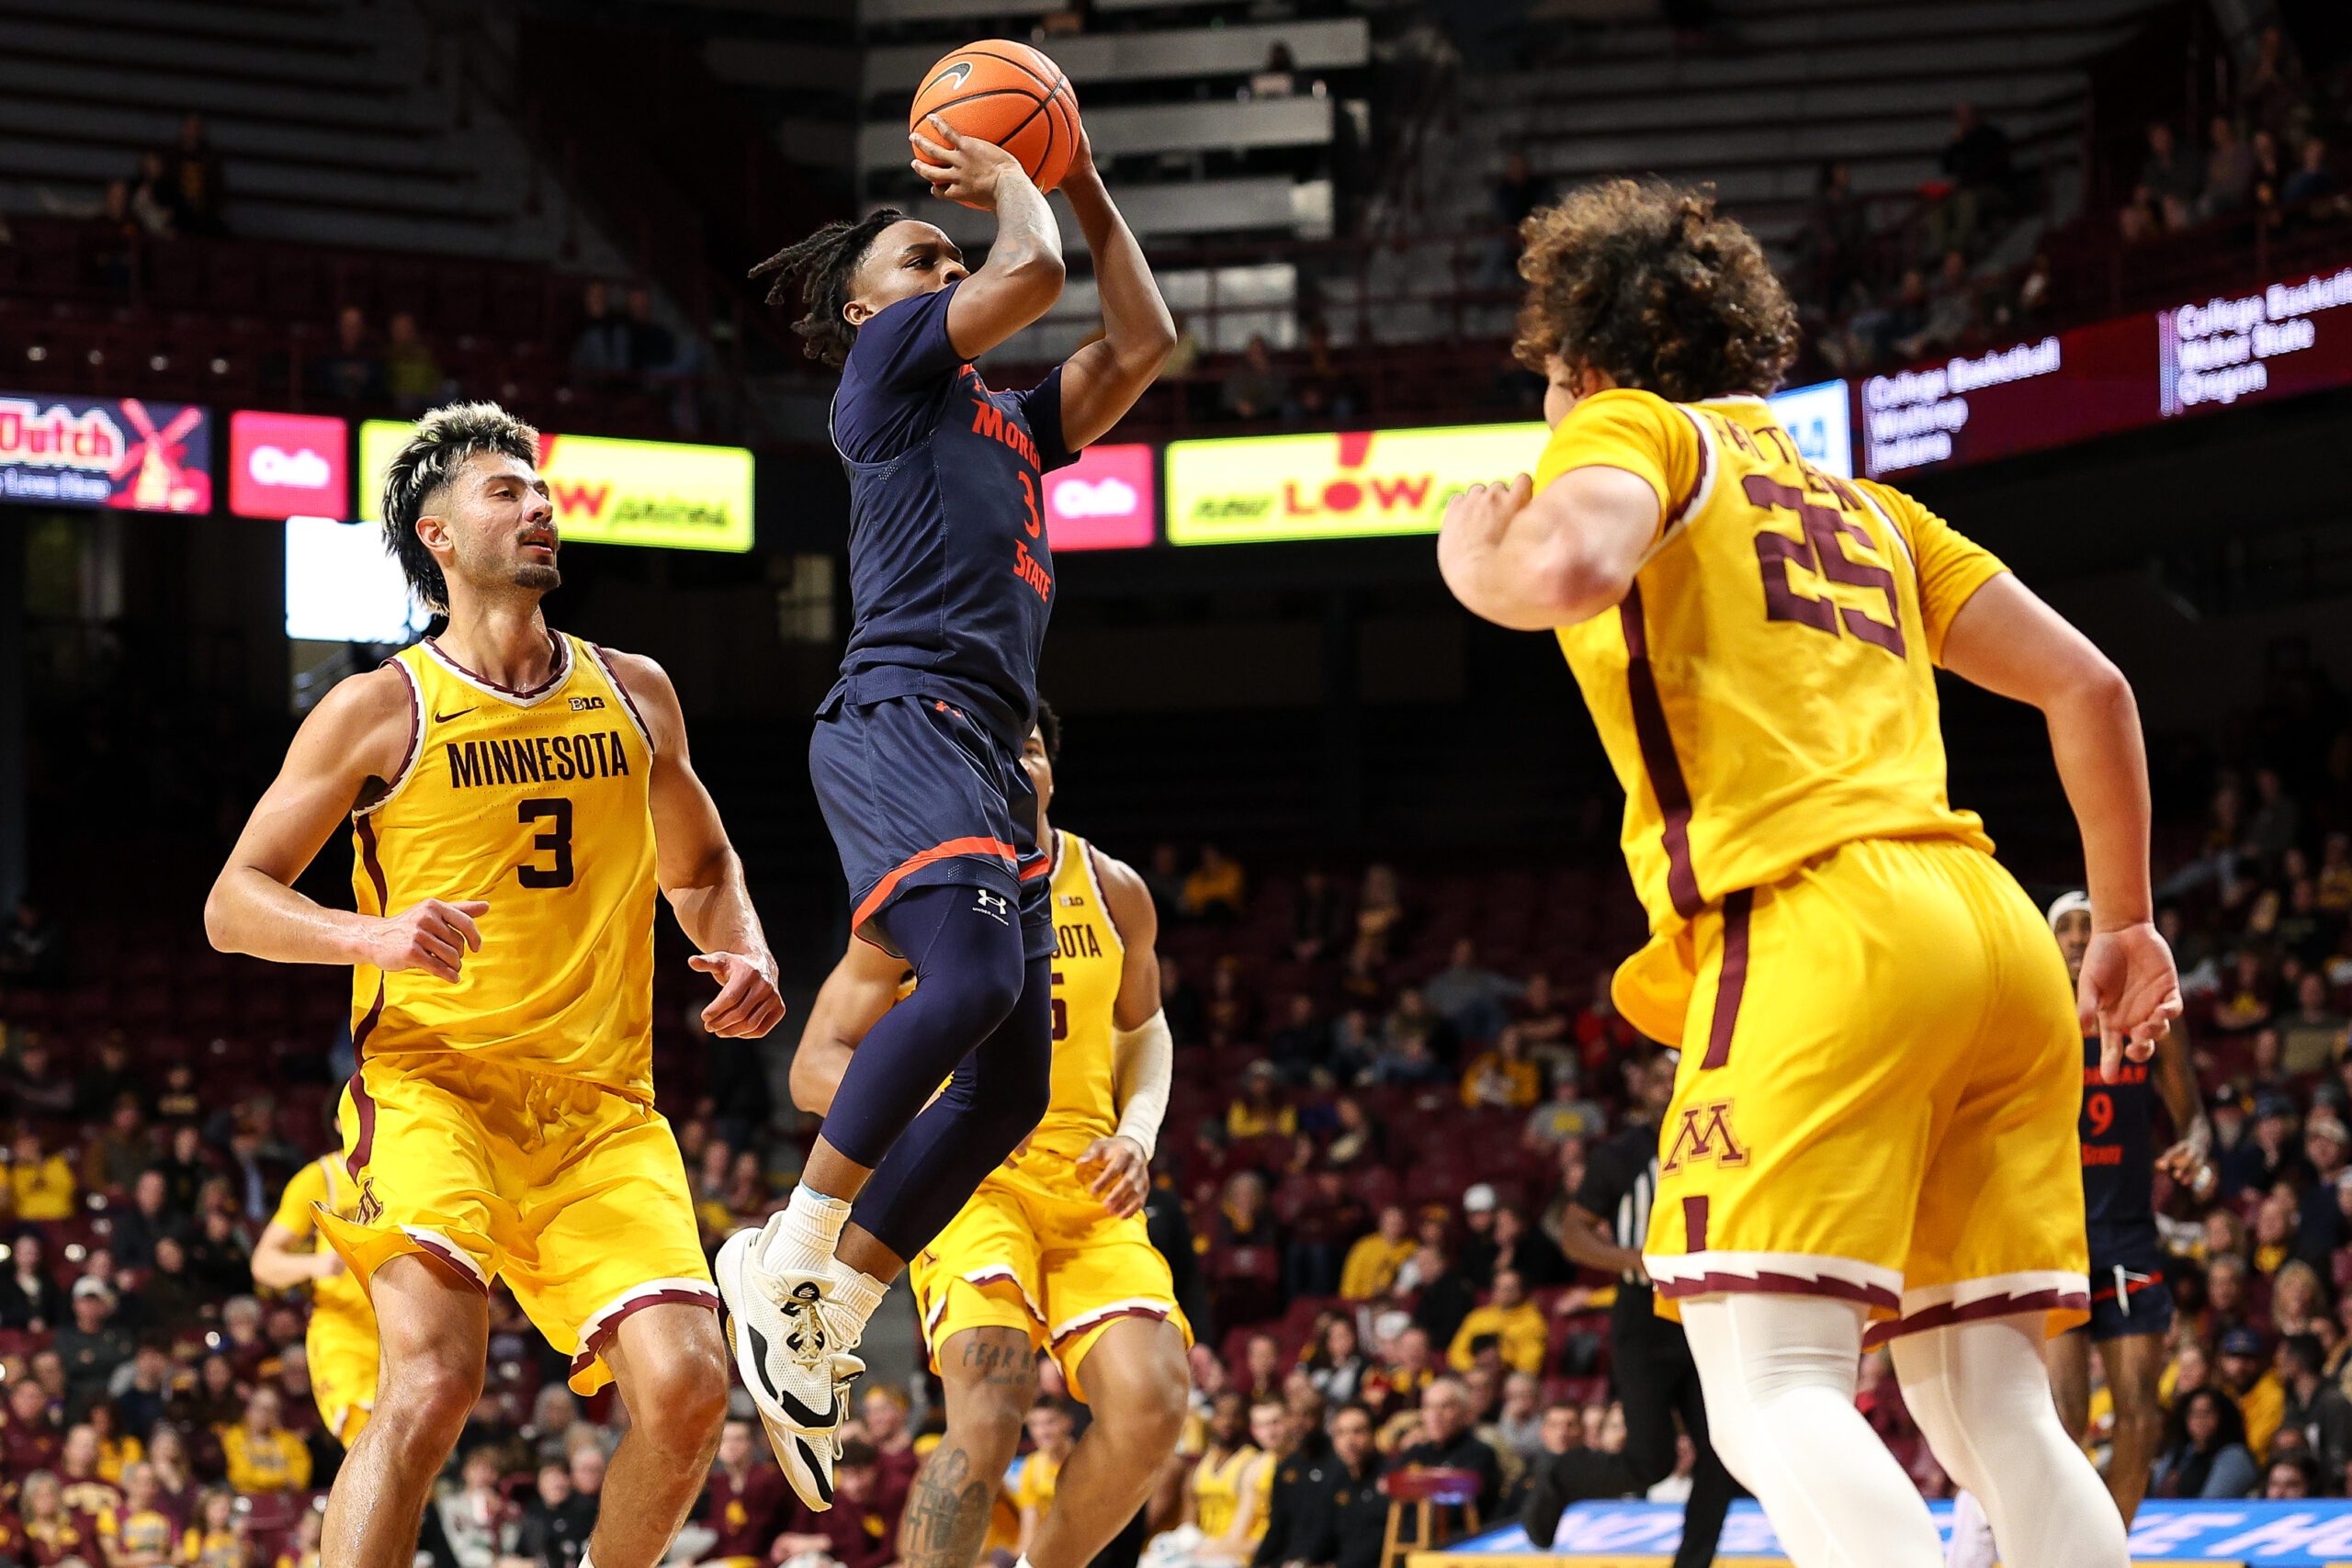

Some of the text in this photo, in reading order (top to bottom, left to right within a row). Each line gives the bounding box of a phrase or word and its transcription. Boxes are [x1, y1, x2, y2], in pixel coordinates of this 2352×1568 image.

[971, 399, 1041, 475] MORG
[1018, 470, 1041, 539] 3
[1285, 474, 1432, 515] LOW
[1741, 473, 1905, 660] 25
[447, 731, 629, 788] MINNESOTA
[517, 797, 574, 888] 3
[2086, 1091, 2115, 1137] 9
